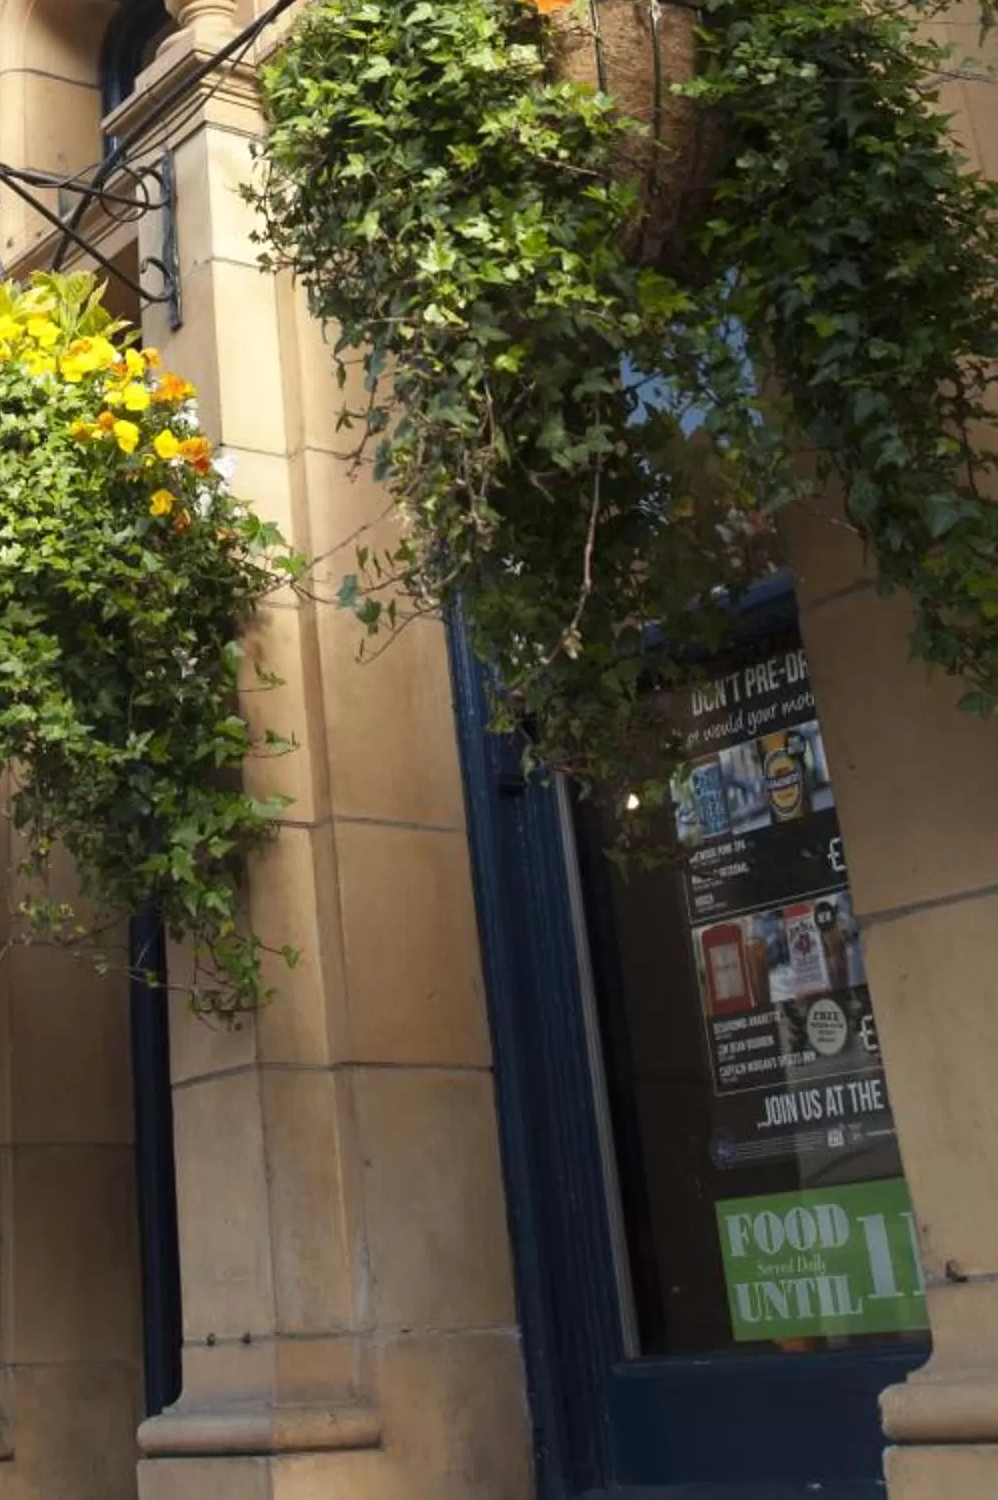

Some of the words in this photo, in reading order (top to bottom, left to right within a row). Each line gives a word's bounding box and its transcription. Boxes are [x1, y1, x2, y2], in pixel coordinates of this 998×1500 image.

[691, 671, 741, 717] DON'T
[800, 1088, 823, 1121] US
[825, 1085, 845, 1117] AT
[847, 1078, 885, 1113] THE
[725, 1203, 850, 1258] FOOD
[735, 1274, 863, 1324] UNTIL
